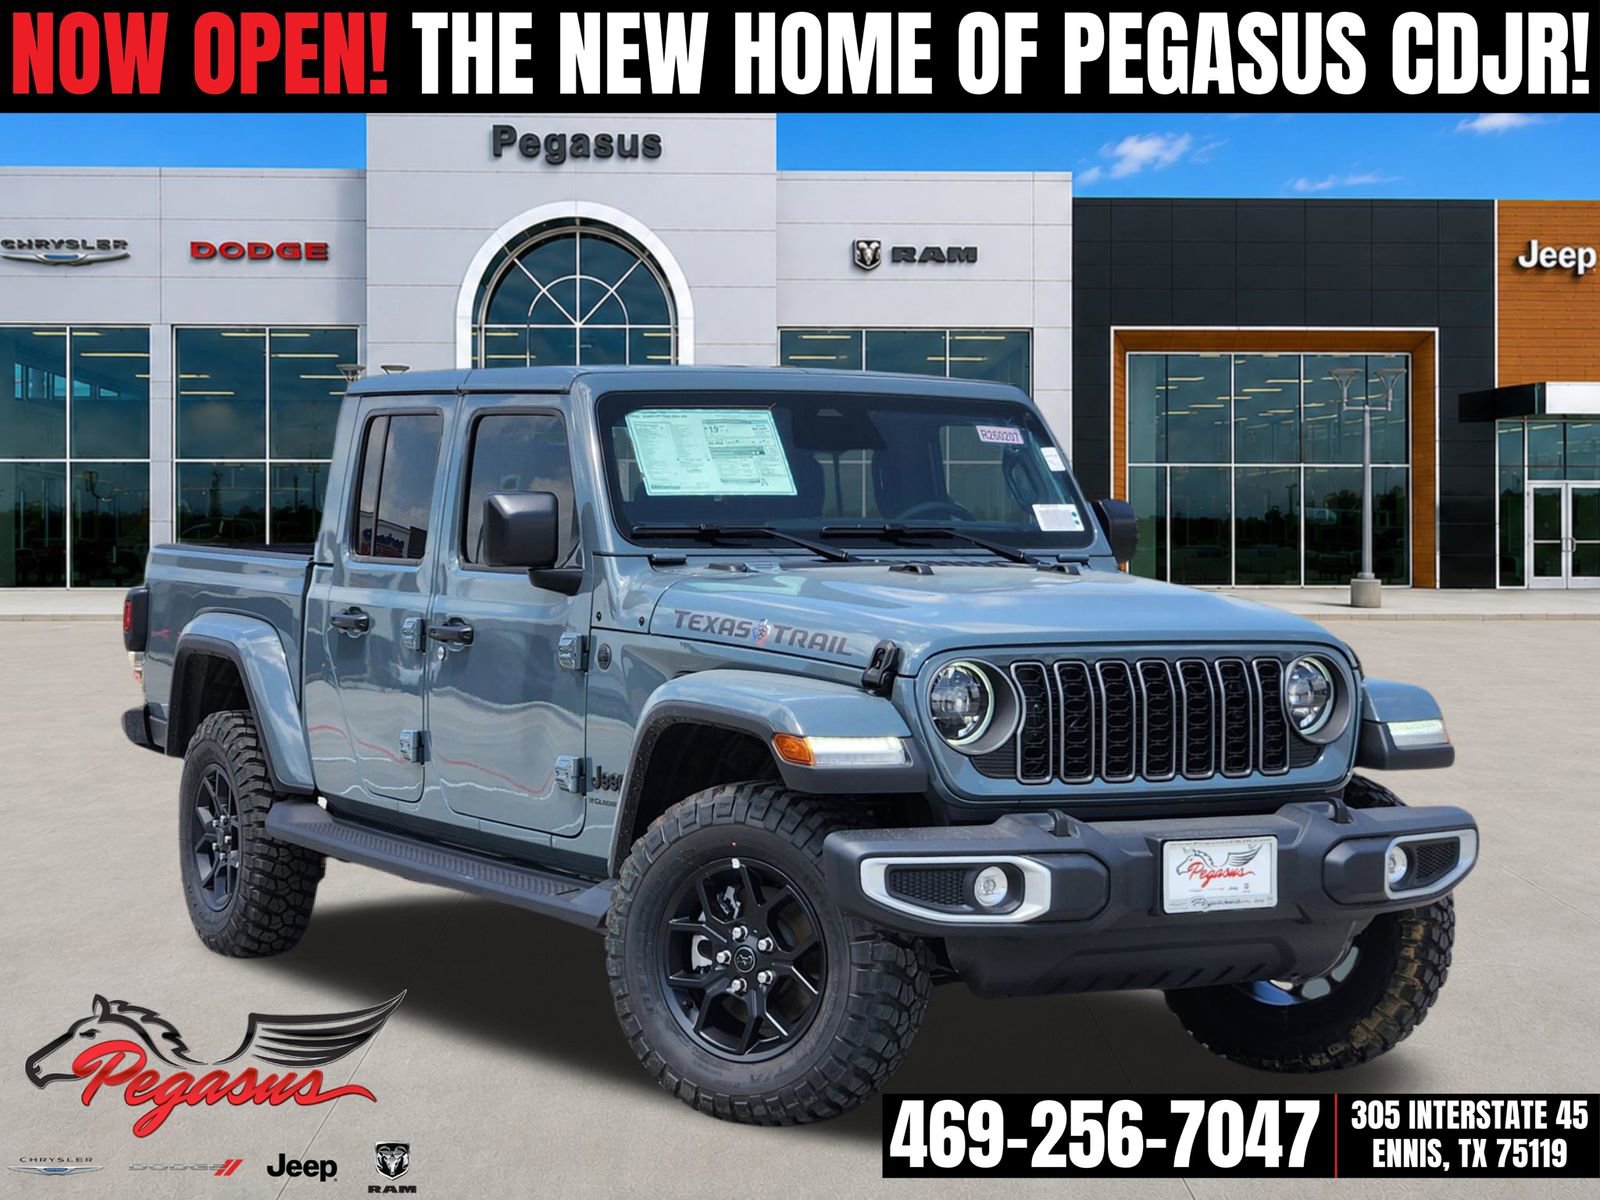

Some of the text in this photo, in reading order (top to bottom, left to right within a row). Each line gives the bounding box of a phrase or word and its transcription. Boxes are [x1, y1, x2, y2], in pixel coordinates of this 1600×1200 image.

[492, 124, 662, 165] Pegasus
[0, 238, 129, 250] CHRYSLER
[190, 241, 330, 260] DODGE
[891, 246, 978, 263] RAM
[1518, 239, 1597, 275] Jeep
[674, 609, 852, 657] TEXAS TRAIL
[1187, 860, 1257, 888] Pegasus
